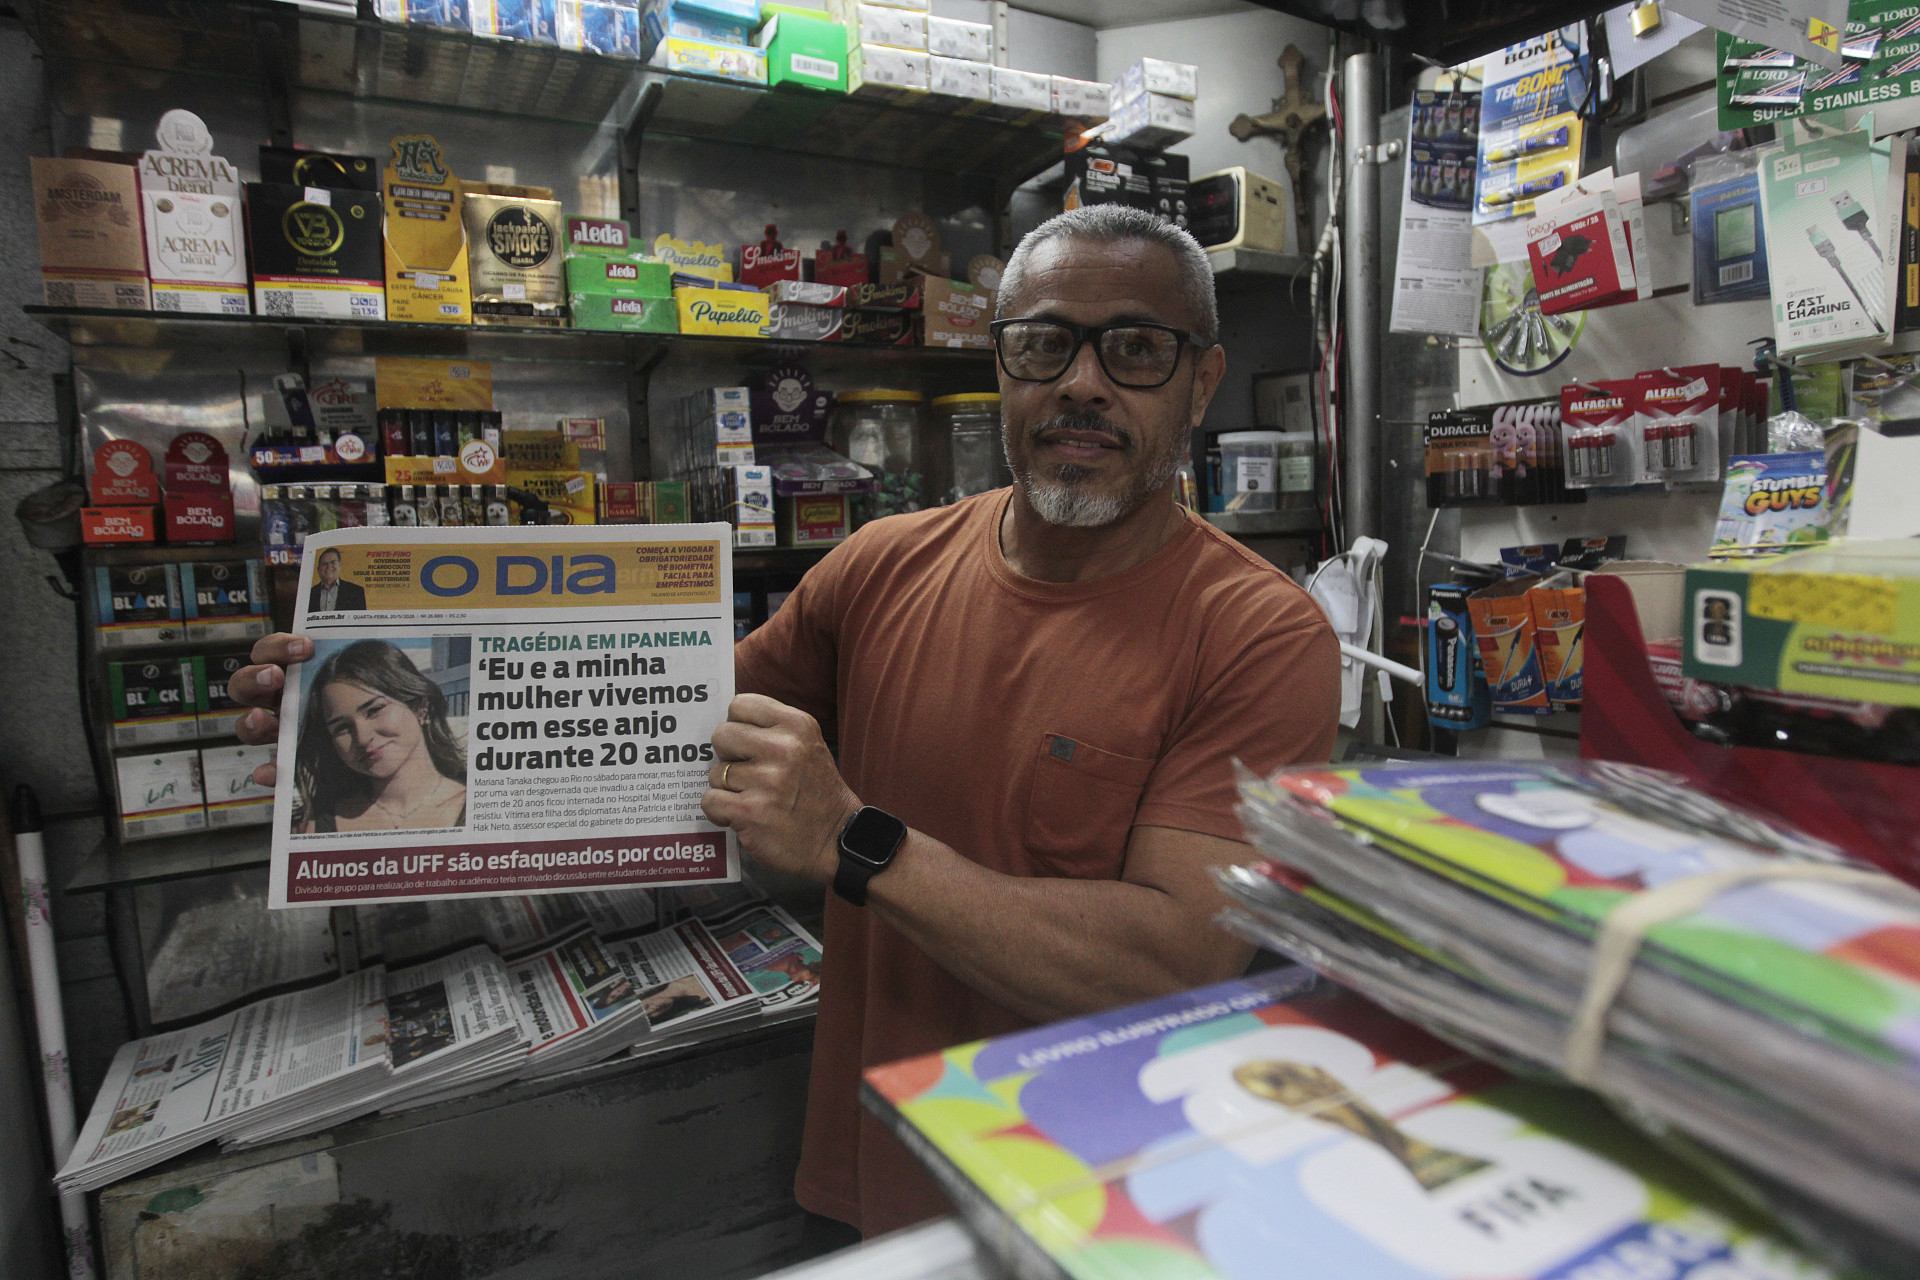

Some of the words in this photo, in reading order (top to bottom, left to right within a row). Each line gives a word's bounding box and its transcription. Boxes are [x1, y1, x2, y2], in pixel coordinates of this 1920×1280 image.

[1846, 23, 1866, 33] RD
[1885, 43, 1919, 58] LORD
[1752, 70, 1789, 80] LORD
[1753, 101, 1805, 122] SUPER
[1813, 83, 1901, 111] STAINLESS
[144, 154, 234, 183] ACREMA
[168, 178, 214, 195] blend
[47, 187, 122, 203] AMSTERDAM
[162, 236, 232, 256] ACREMA
[492, 233, 548, 256] SMOKE
[180, 251, 216, 266] blend
[658, 247, 722, 268] Papelito
[744, 246, 798, 270] Smoking
[411, 291, 444, 300] CÂNCER
[789, 283, 832, 301] Smoking
[442, 306, 458, 314] 136
[1787, 295, 1825, 310] FAST
[1788, 301, 1851, 320] CHARING
[362, 307, 379, 316] 136
[690, 301, 765, 325] Papelito
[769, 304, 832, 332] Smoking
[1570, 398, 1624, 411] ALFACELL
[773, 414, 800, 423] BEM
[760, 423, 810, 433] BOLADO
[1431, 424, 1489, 437] DURACELL
[256, 450, 274, 464] 50
[395, 470, 412, 481] 25
[1752, 475, 1828, 492] STUMBLE
[1745, 487, 1821, 516] GUYS
[187, 507, 212, 516] BEM
[105, 517, 132, 526] BEM
[176, 514, 224, 526] BOLADO
[94, 525, 144, 536] BOLADO
[271, 550, 289, 564] 50
[636, 547, 669, 555] COMEÇA
[669, 563, 713, 571] BIOMETRIA
[420, 555, 479, 597] O
[656, 580, 714, 588] EMPRÉSTIMOS
[1431, 590, 1461, 598] Panasonic
[306, 613, 345, 622] odia.com.br
[479, 631, 582, 653] TRAGÉDIA
[587, 634, 616, 650] EM
[620, 630, 712, 649] IPANEMA
[530, 661, 547, 680] e
[552, 661, 570, 679] a
[576, 653, 666, 678] minha
[477, 685, 583, 711] mulher
[588, 683, 708, 707] vivemos
[476, 720, 538, 741] com
[543, 717, 609, 738] esse
[614, 710, 677, 739] anjo
[475, 745, 594, 771] durante
[600, 741, 638, 766] 20
[644, 742, 714, 764] anos
[474, 778, 504, 786] Mariana
[506, 777, 532, 785] Tanaka
[533, 776, 559, 787] chegou
[593, 773, 619, 782] sábado
[637, 771, 659, 781] morar,
[526, 785, 581, 797] desgovernada
[600, 783, 628, 793] invadiu
[636, 781, 666, 792] calçada
[473, 800, 499, 811] jovem
[546, 797, 565, 806] ficou
[567, 795, 605, 805] internada
[618, 793, 650, 803] Hospital
[653, 791, 678, 802] Miguel
[679, 791, 703, 800] Couto
[473, 812, 503, 820] resistiu.
[505, 810, 530, 819] Vítima
[545, 808, 562, 817] filha
[578, 806, 620, 816] diplomatas
[638, 803, 666, 812] Patrícia
[490, 822, 511, 831] Neto,
[513, 821, 545, 830] assessor
[547, 819, 577, 829] especial
[590, 817, 623, 828] gabinete
[636, 814, 675, 825] presidente
[676, 813, 693, 822] Lula.
[296, 858, 369, 880] Alunos
[372, 856, 398, 876] da
[403, 854, 444, 874] UFF
[447, 852, 483, 872] são
[487, 846, 614, 871] esfaqueados
[617, 847, 650, 866] por
[653, 841, 716, 862] colega
[295, 885, 323, 895] Divisão
[334, 884, 357, 895] grupo
[376, 879, 414, 891] realização
[426, 878, 458, 887] trabalho
[459, 875, 499, 886] acadêmico
[500, 875, 516, 884] teria
[517, 873, 552, 883] motivado
[553, 871, 587, 881] discussão
[588, 870, 607, 878] entre
[608, 868, 647, 878] estudantes
[658, 866, 686, 875] Cinema.
[1458, 1175, 1578, 1240] FIFA
